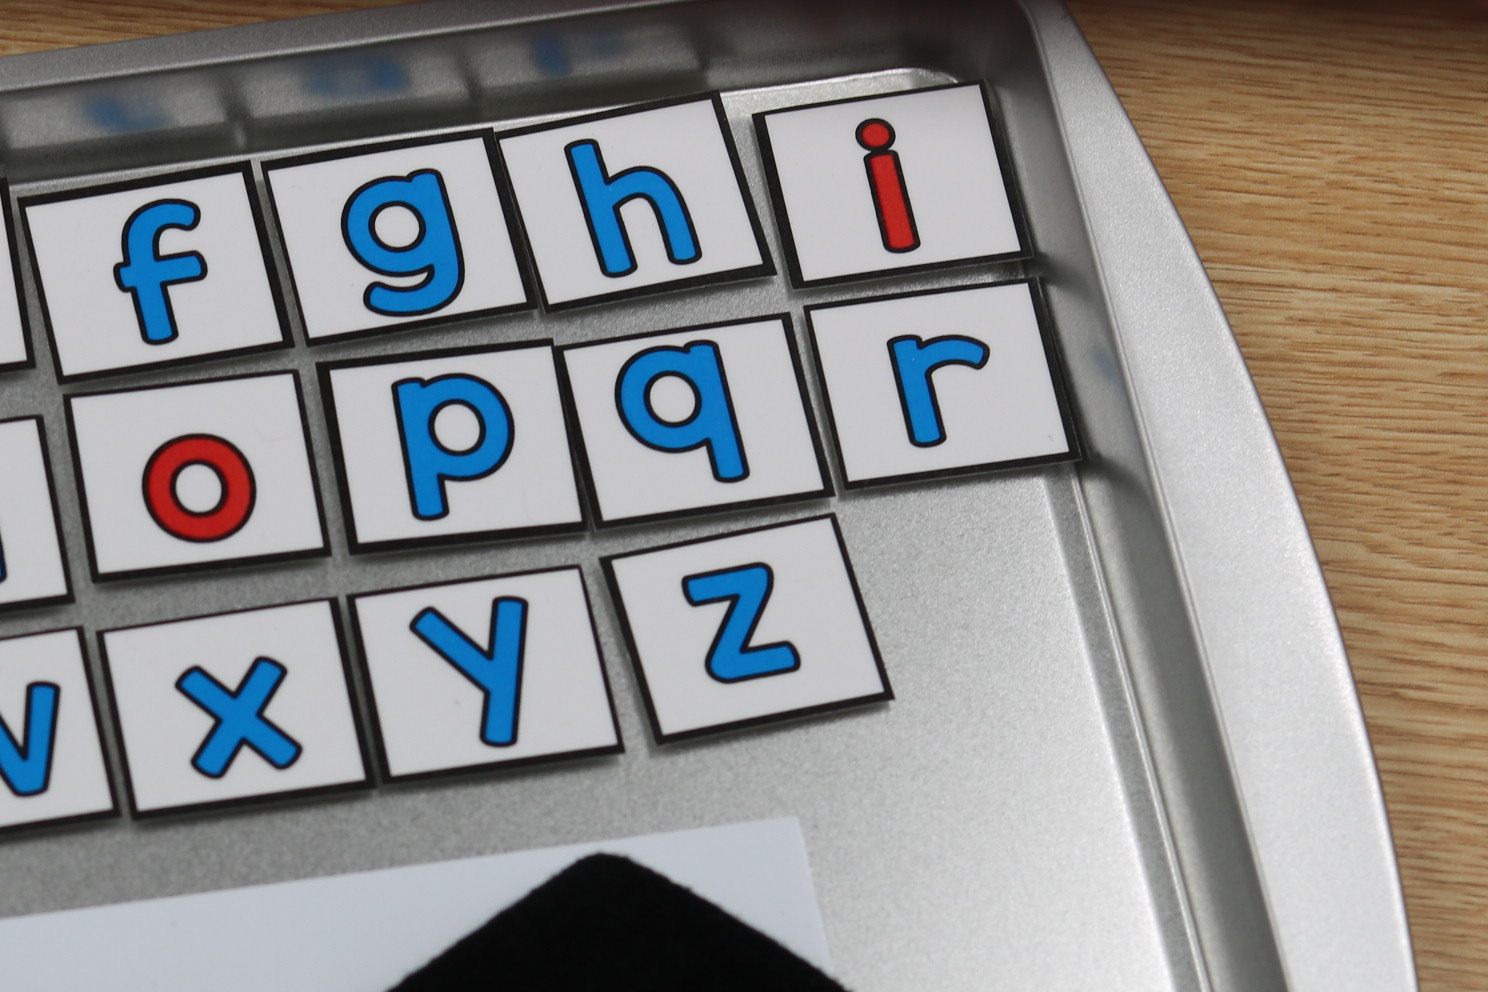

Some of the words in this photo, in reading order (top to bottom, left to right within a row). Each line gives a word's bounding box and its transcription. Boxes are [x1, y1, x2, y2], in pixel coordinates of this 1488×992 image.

[116, 200, 206, 344] f
[343, 170, 463, 316] g
[567, 140, 700, 276] h
[857, 118, 918, 252] i
[143, 434, 256, 543] o
[393, 375, 513, 520] p
[616, 342, 748, 481] q
[890, 336, 987, 446] r
[177, 658, 301, 778] x
[411, 597, 527, 746] y
[683, 564, 799, 682] z
